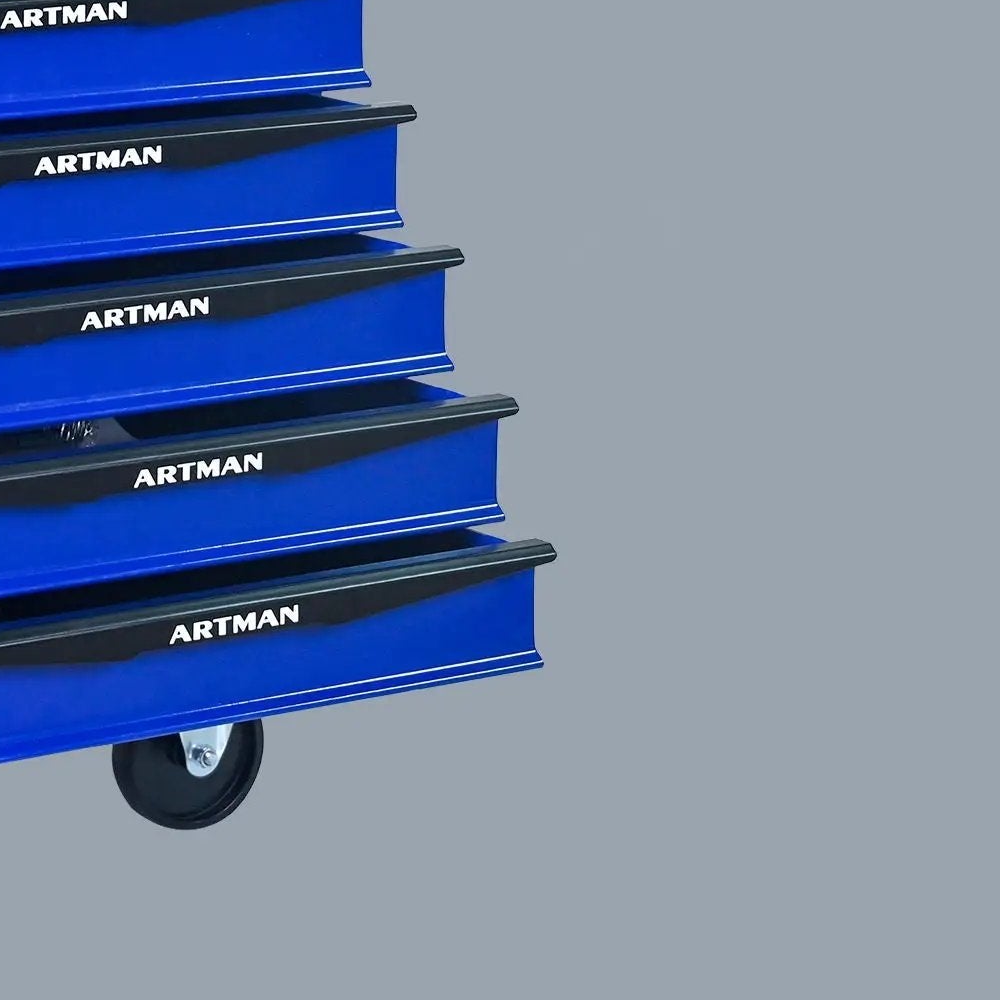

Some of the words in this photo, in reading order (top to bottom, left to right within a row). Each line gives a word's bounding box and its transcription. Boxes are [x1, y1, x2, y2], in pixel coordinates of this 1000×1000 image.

[0, 0, 128, 30] ARTMAN
[33, 145, 162, 176] ARTMAN
[80, 296, 209, 331] ARTMAN
[133, 452, 263, 489] ARTMAN
[169, 604, 299, 645] ARTMAN
